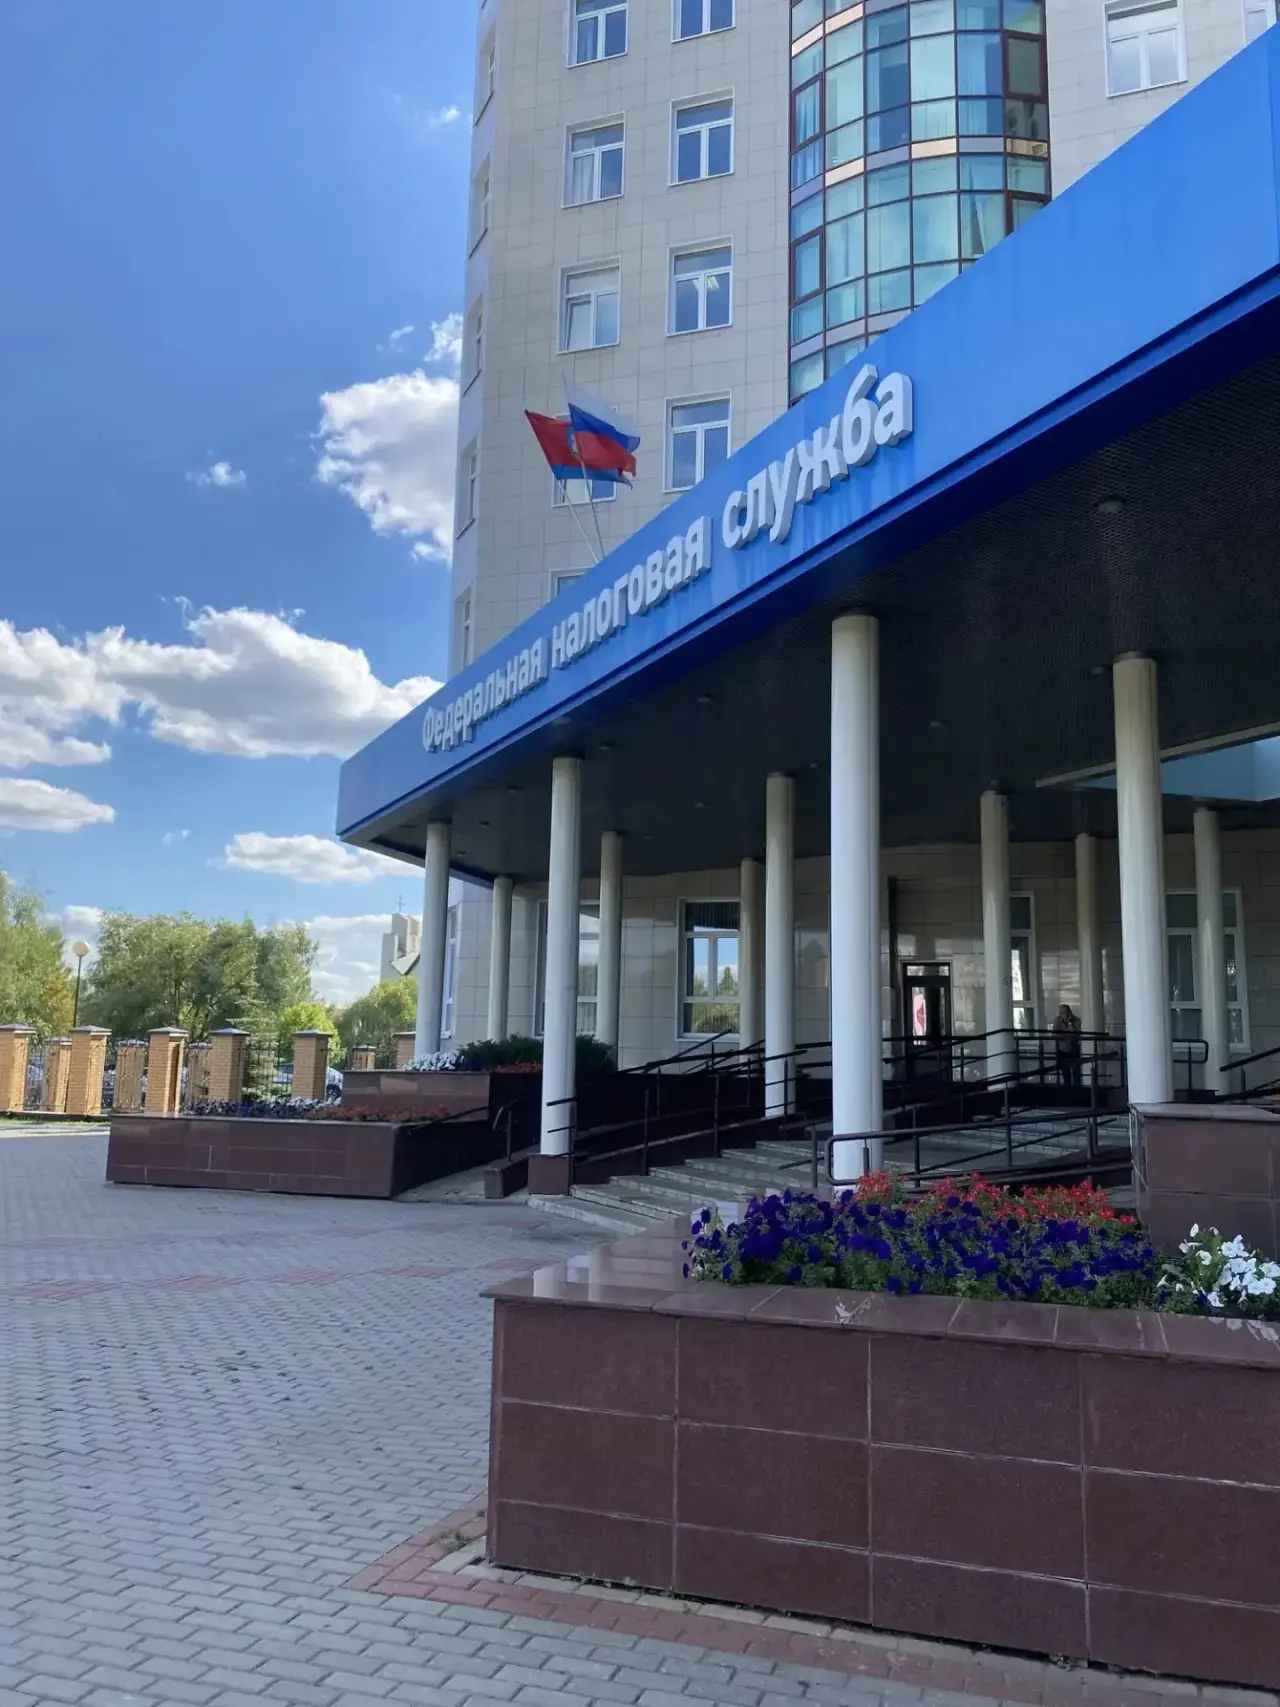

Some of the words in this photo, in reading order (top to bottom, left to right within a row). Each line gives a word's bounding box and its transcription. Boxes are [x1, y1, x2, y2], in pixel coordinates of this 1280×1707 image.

[421, 636, 548, 753] Федеральная
[551, 516, 712, 670] налоговая
[722, 364, 914, 550] служба
